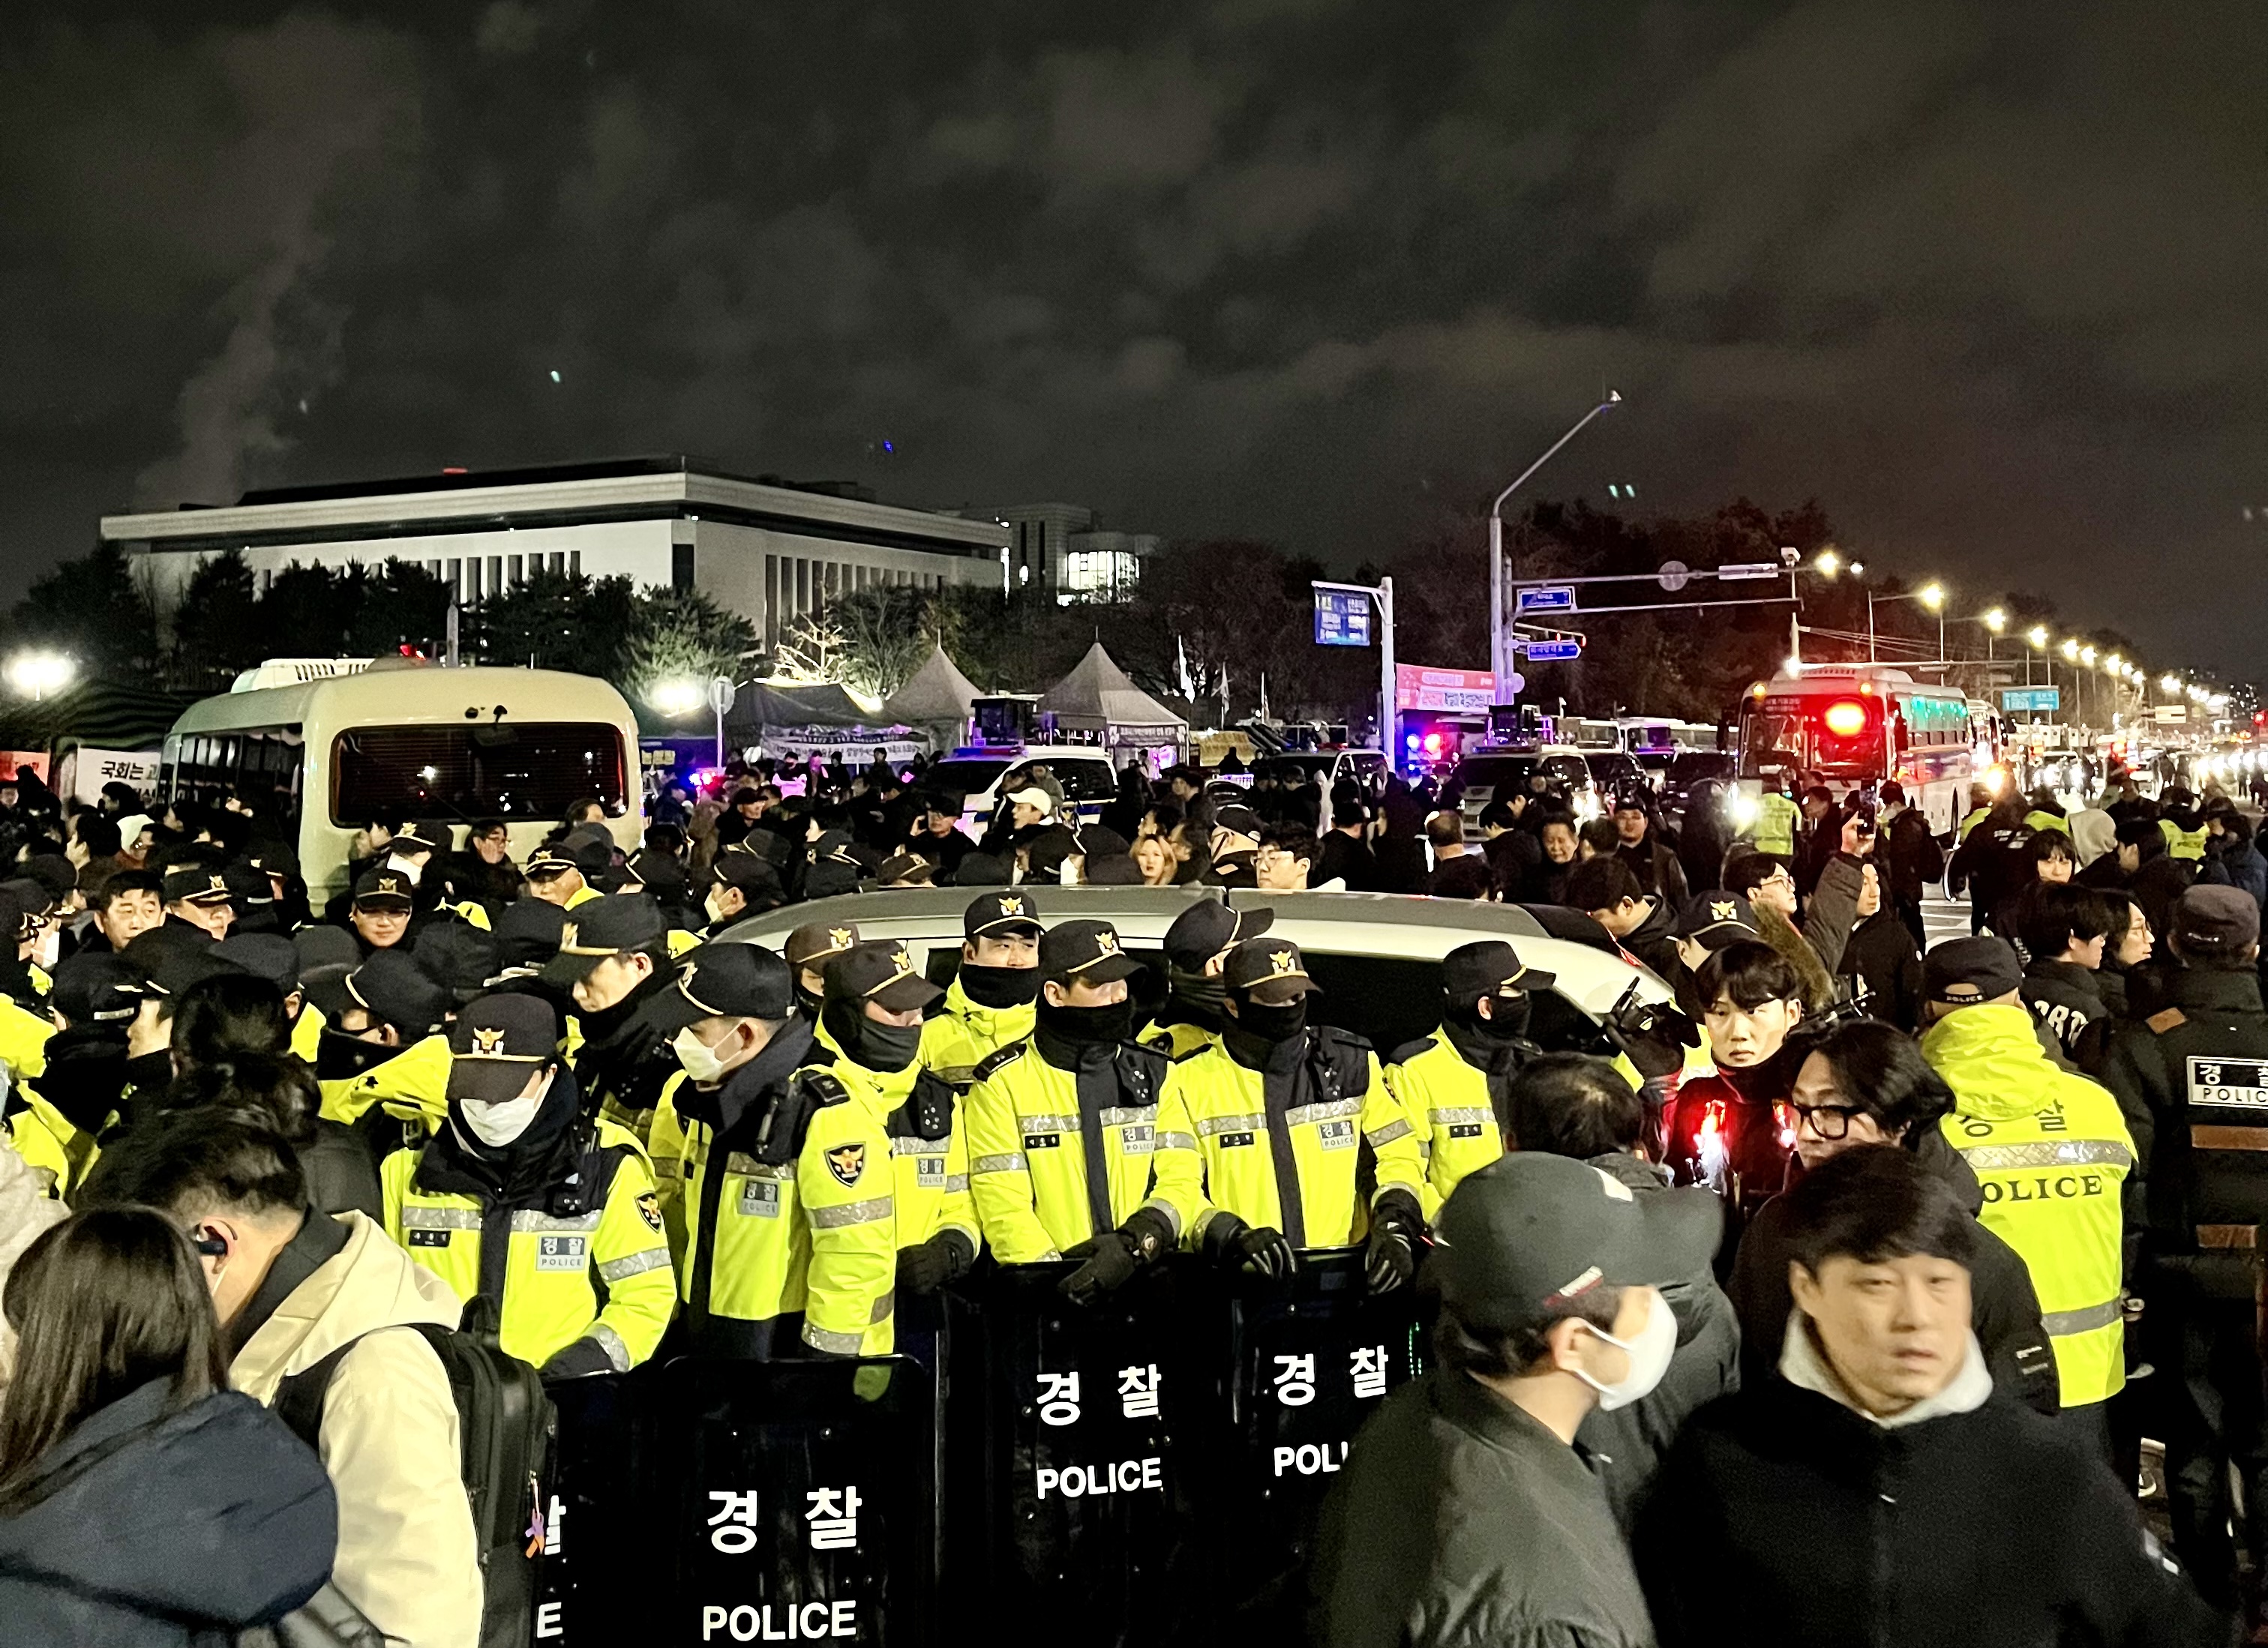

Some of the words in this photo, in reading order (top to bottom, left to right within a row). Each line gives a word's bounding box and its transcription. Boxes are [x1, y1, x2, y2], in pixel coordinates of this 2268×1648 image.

[101, 761, 143, 780] 국회는
[1946, 994, 1984, 1002] POLICE
[1982, 1174, 2103, 1203] OLICE
[743, 1202, 776, 1213] POLICE
[541, 1258, 581, 1266] POLICE
[1036, 1458, 1163, 1499] POLICE
[704, 1601, 856, 1641] POLICE
